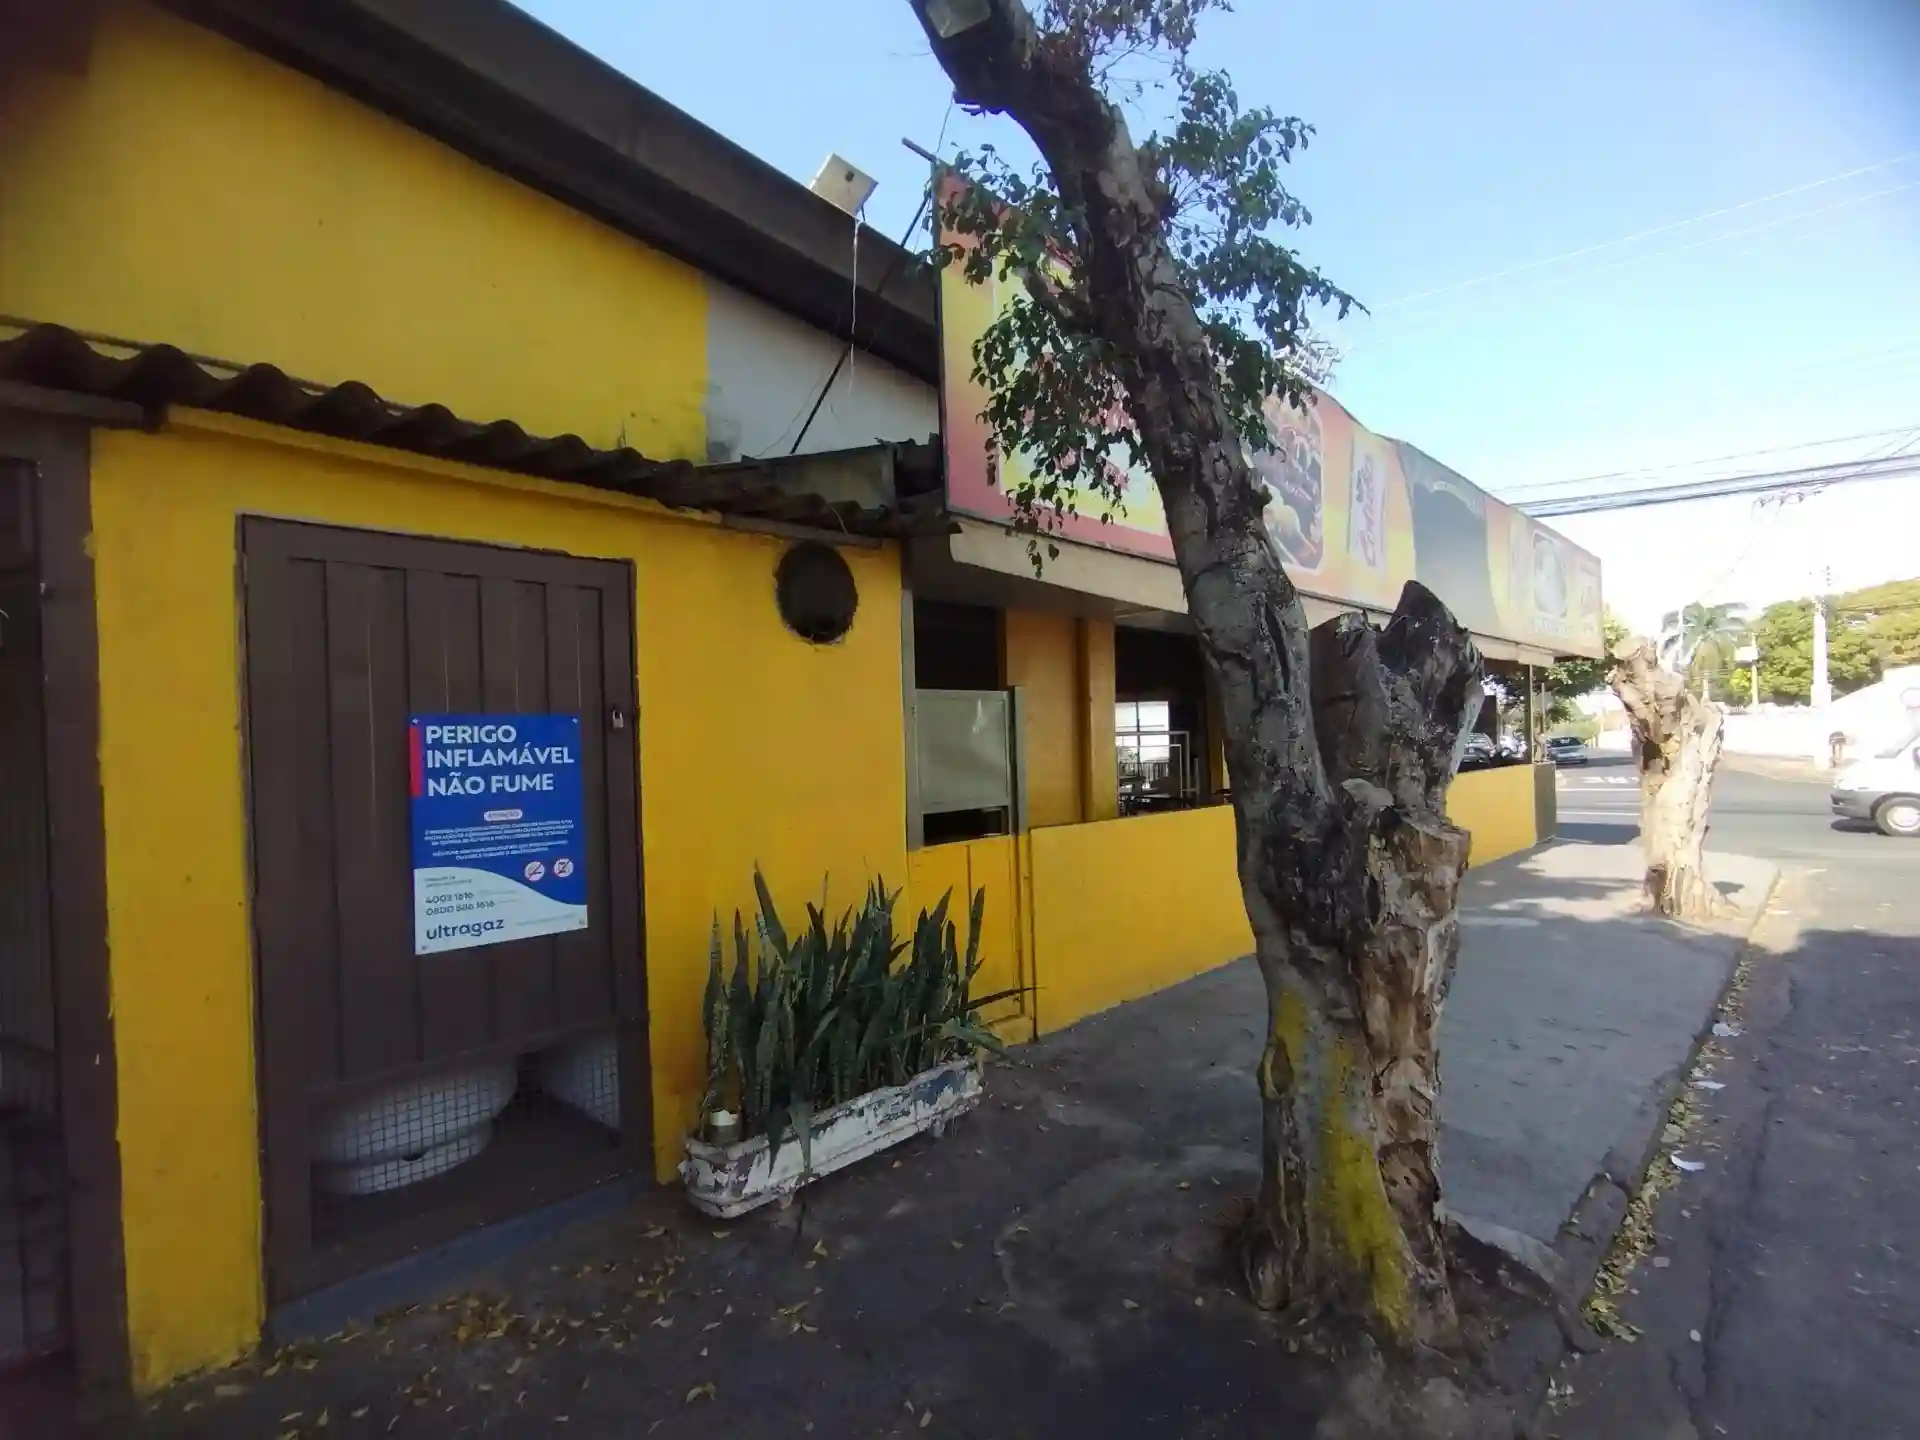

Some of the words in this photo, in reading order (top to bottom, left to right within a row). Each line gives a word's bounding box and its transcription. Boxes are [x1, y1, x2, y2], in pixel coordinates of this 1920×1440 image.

[426, 725, 517, 744] PERIGO
[427, 742, 574, 768] INFLAMÁVEL
[428, 771, 485, 796] NÃO
[491, 773, 554, 793] FUME
[426, 919, 505, 940] ultragaz
